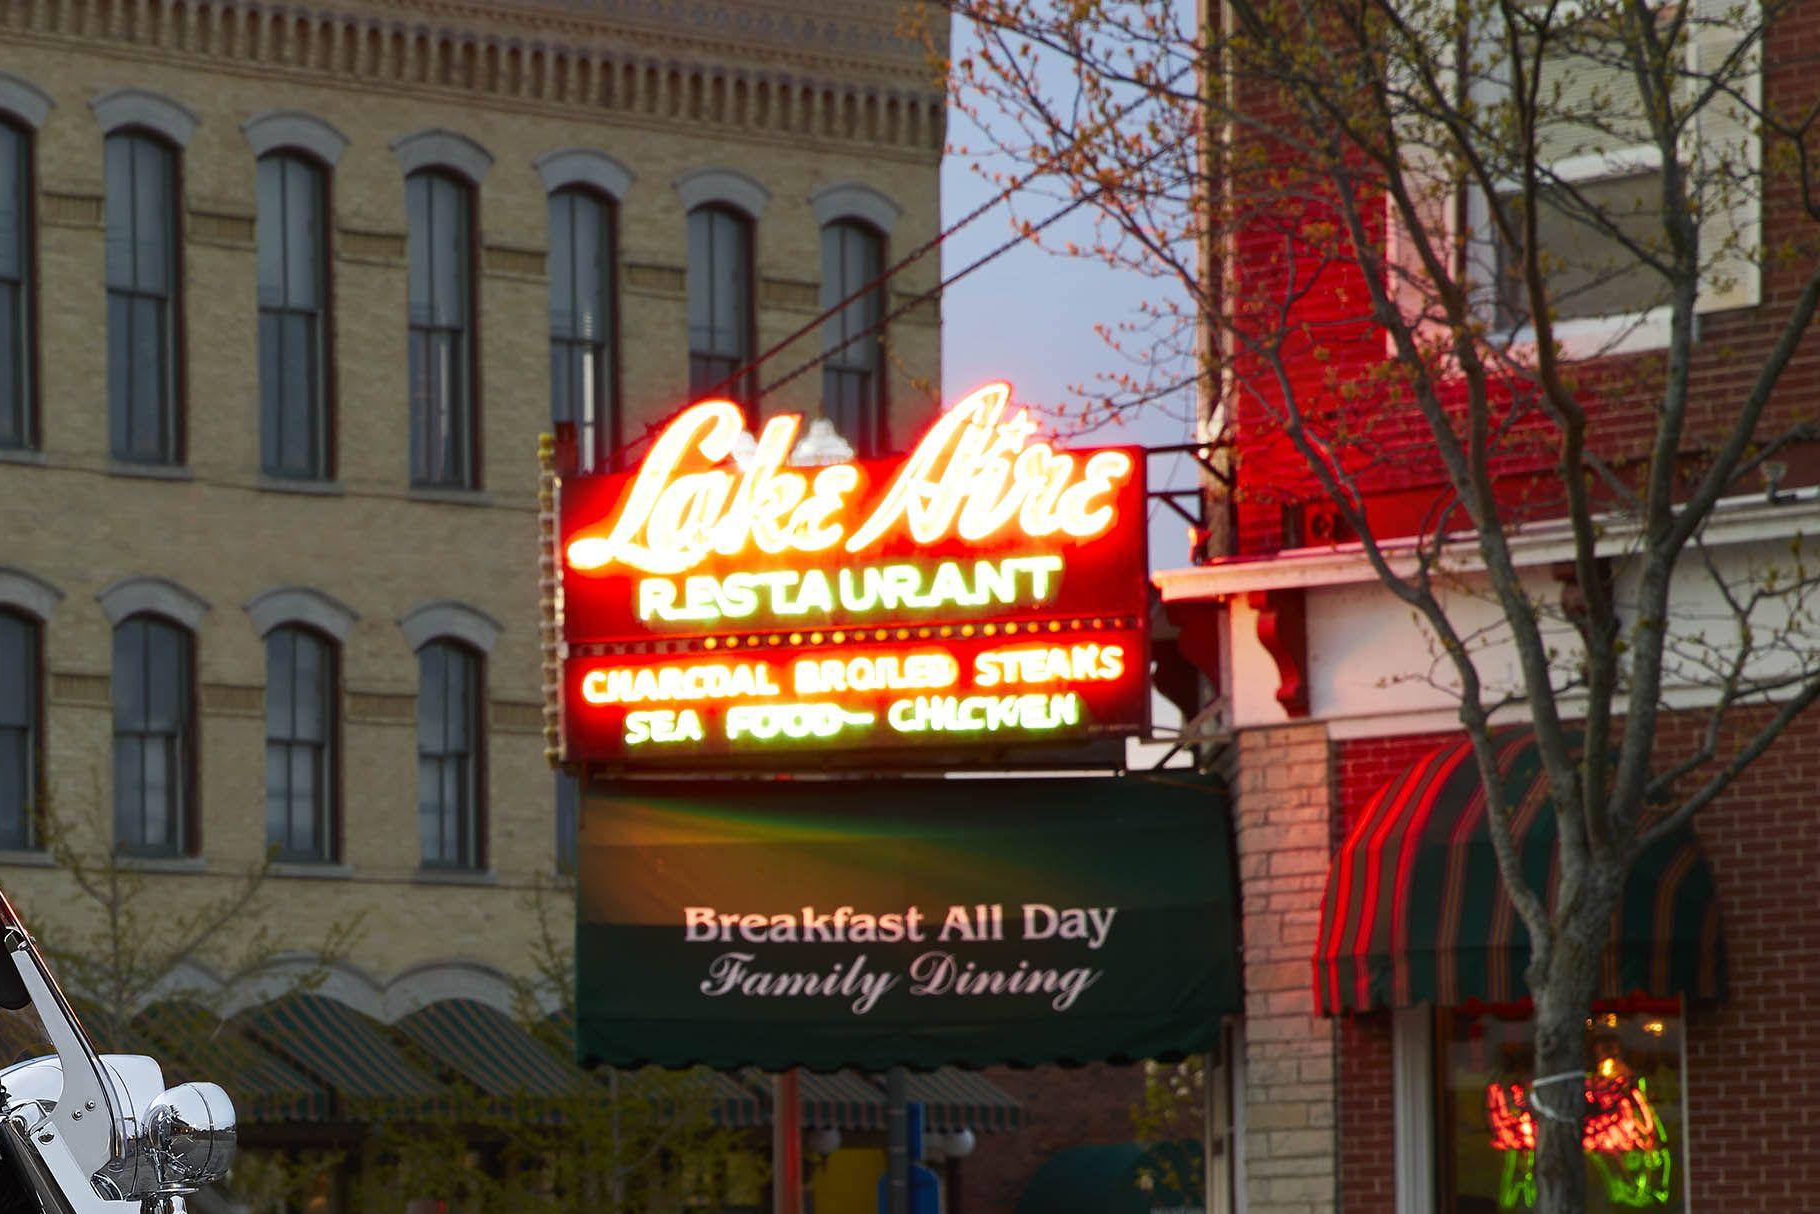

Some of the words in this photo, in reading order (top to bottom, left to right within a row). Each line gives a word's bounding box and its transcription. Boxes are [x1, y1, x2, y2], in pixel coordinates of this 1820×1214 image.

[567, 400, 859, 574] Lake
[639, 555, 1064, 620] RESTAURANT
[582, 664, 780, 703] CHARCOAL
[794, 654, 957, 694] BROILED
[974, 644, 1124, 686] STEAKS
[625, 709, 702, 744] SEA
[888, 691, 1079, 732] CHICKEN
[684, 906, 924, 943] Breakfast
[937, 904, 1003, 941] All
[1022, 903, 1117, 949] Day
[699, 951, 899, 1015] Family
[908, 950, 1103, 1012] Dining
